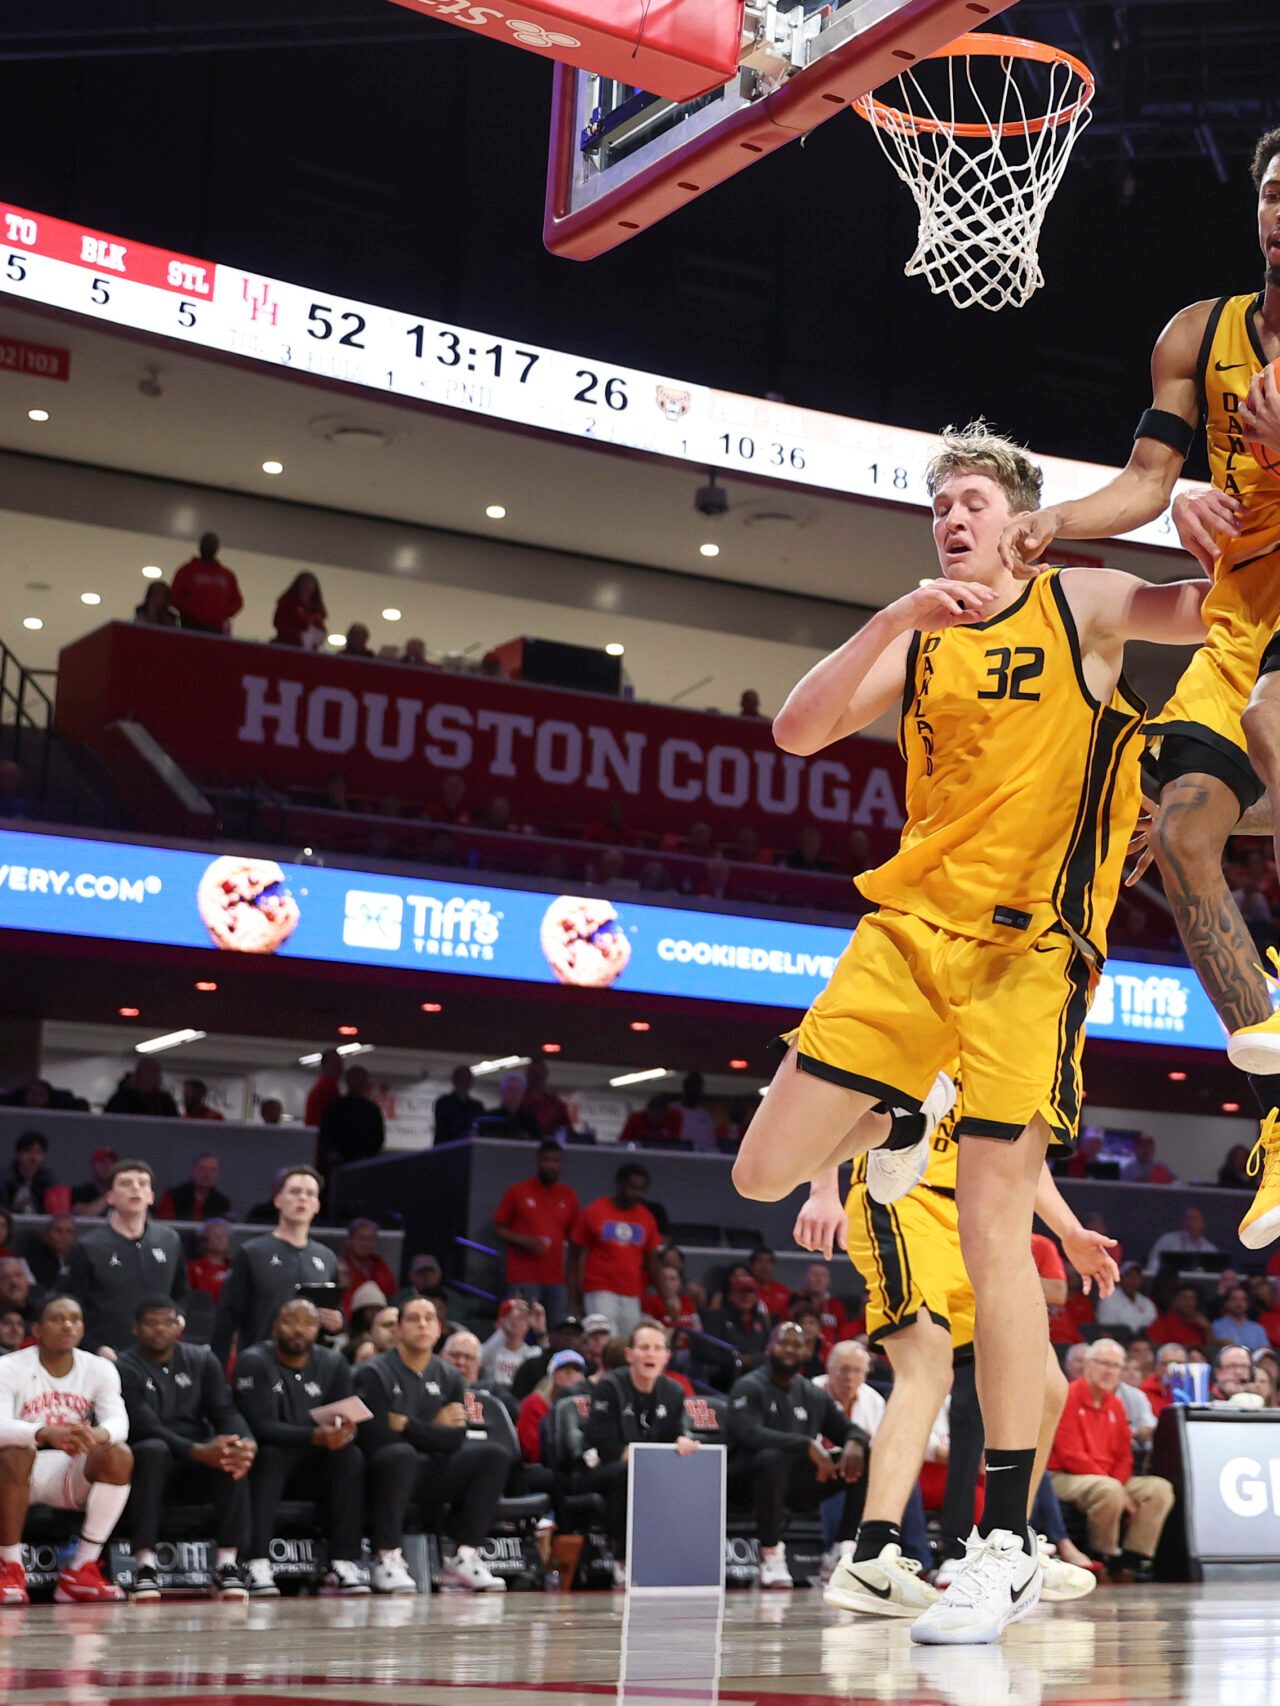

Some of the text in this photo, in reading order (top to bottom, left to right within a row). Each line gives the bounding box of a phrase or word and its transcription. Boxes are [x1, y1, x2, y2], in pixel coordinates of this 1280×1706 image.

[5, 213, 209, 294] TO BLK STL
[6, 253, 197, 328] 5 5 5
[280, 344, 293, 362] 3
[307, 303, 366, 350] 52
[406, 323, 541, 384] 13:17
[573, 369, 628, 411] 26
[977, 646, 1046, 702] 32
[238, 675, 902, 830] HOUSTON COUGA
[413, 938, 494, 960] TREATS
